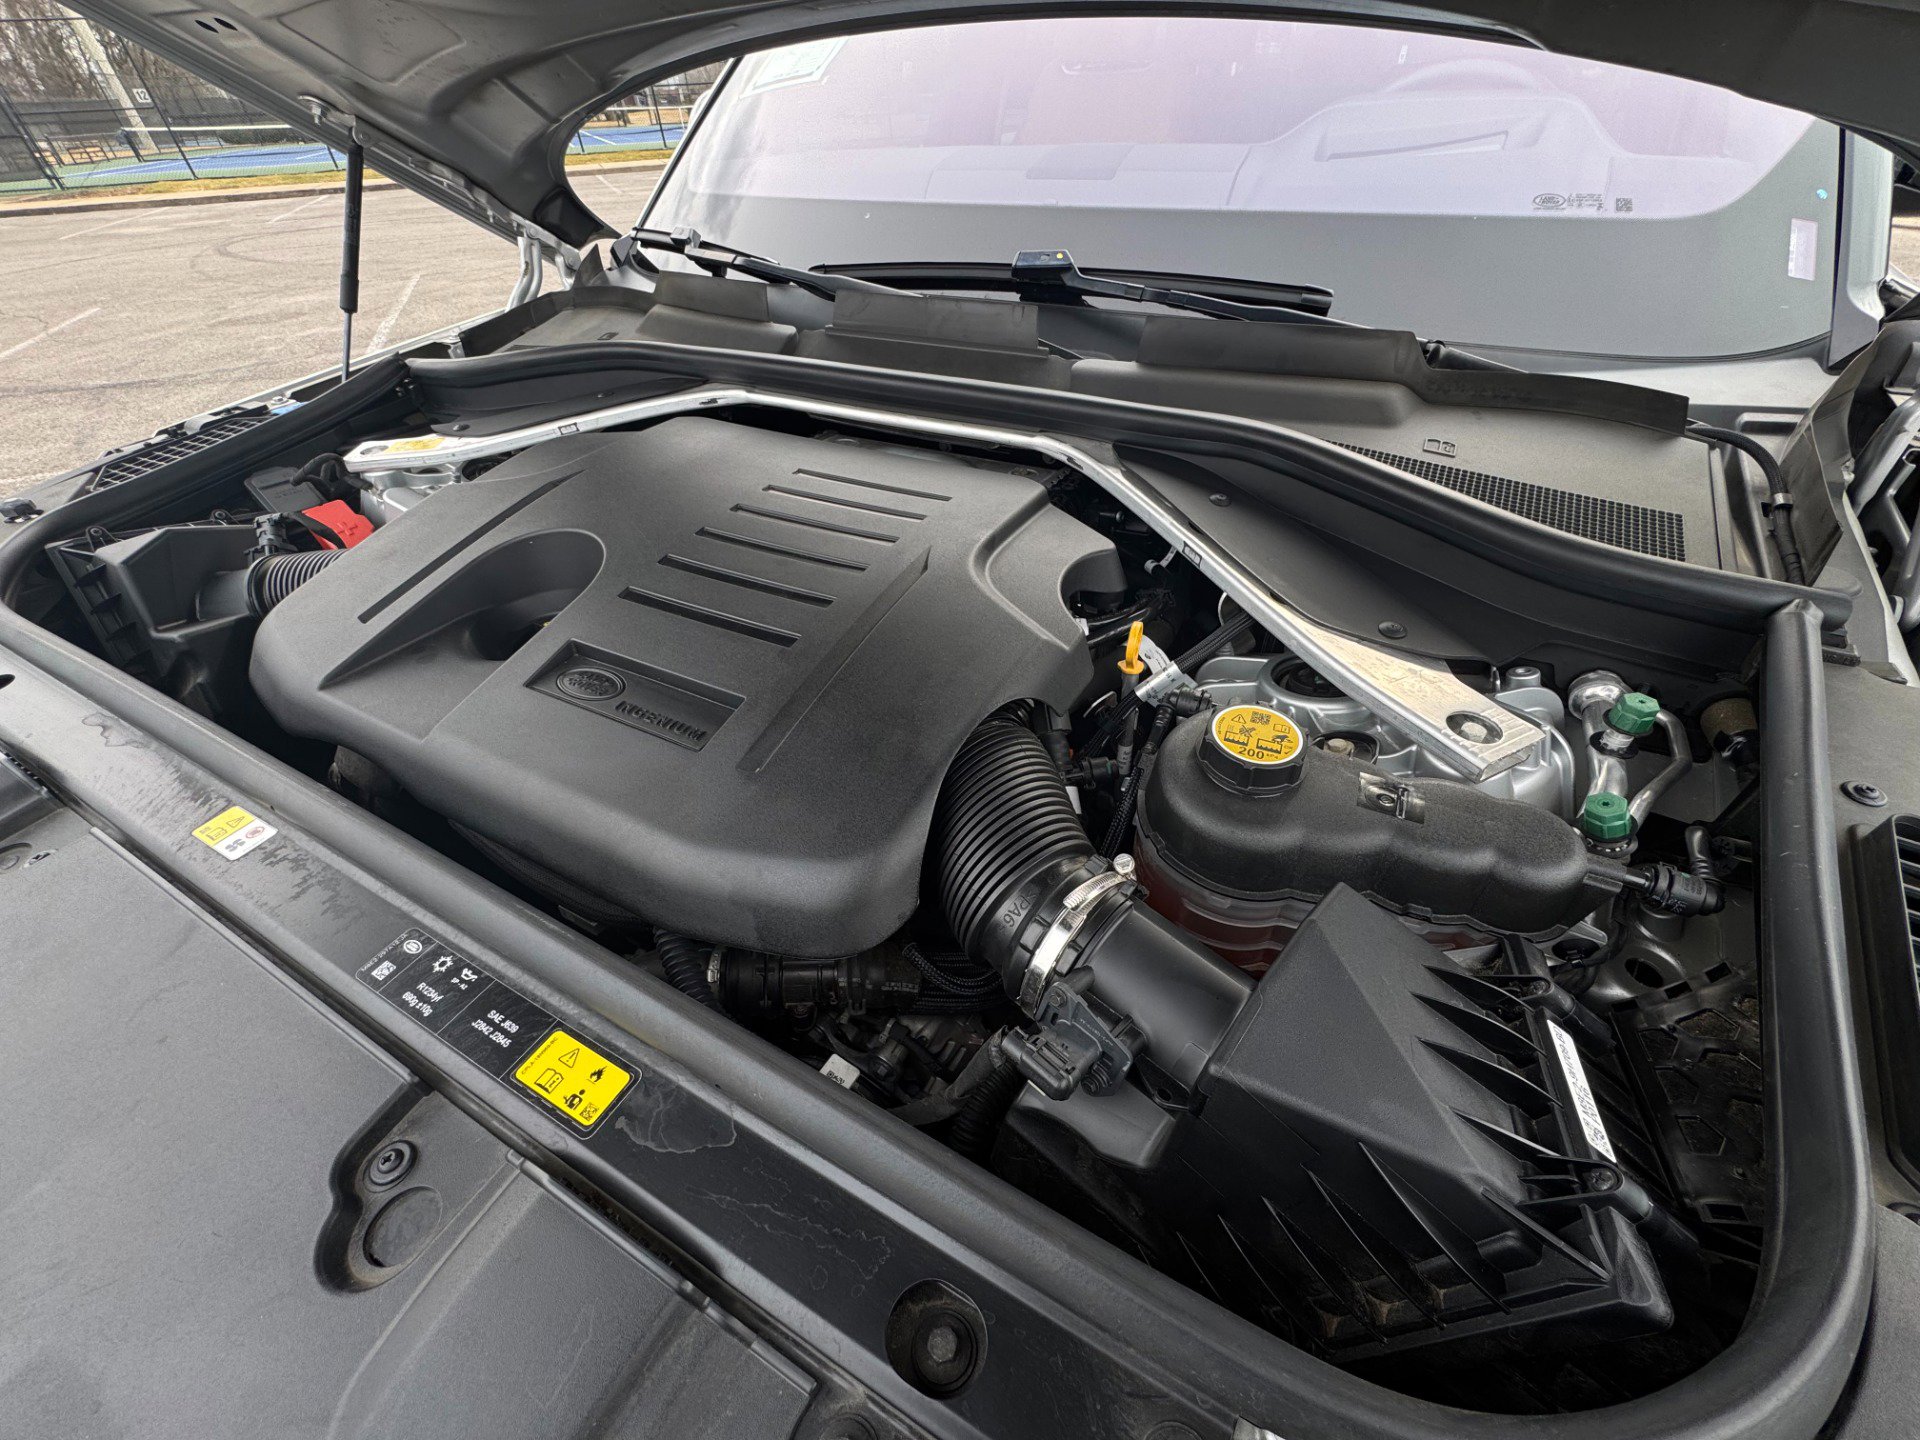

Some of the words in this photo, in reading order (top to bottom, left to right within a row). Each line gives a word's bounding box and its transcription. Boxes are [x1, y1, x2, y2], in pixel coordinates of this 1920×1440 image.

[136, 90, 150, 100] 12
[615, 701, 708, 740] INGENIUM
[1238, 746, 1265, 760] 200
[402, 991, 419, 1007] 690g
[416, 982, 445, 1003] R1234yf
[487, 1009, 505, 1024] SAE
[500, 1019, 520, 1034] J639
[471, 1019, 494, 1036] J2842
[489, 1031, 513, 1048] J2845
